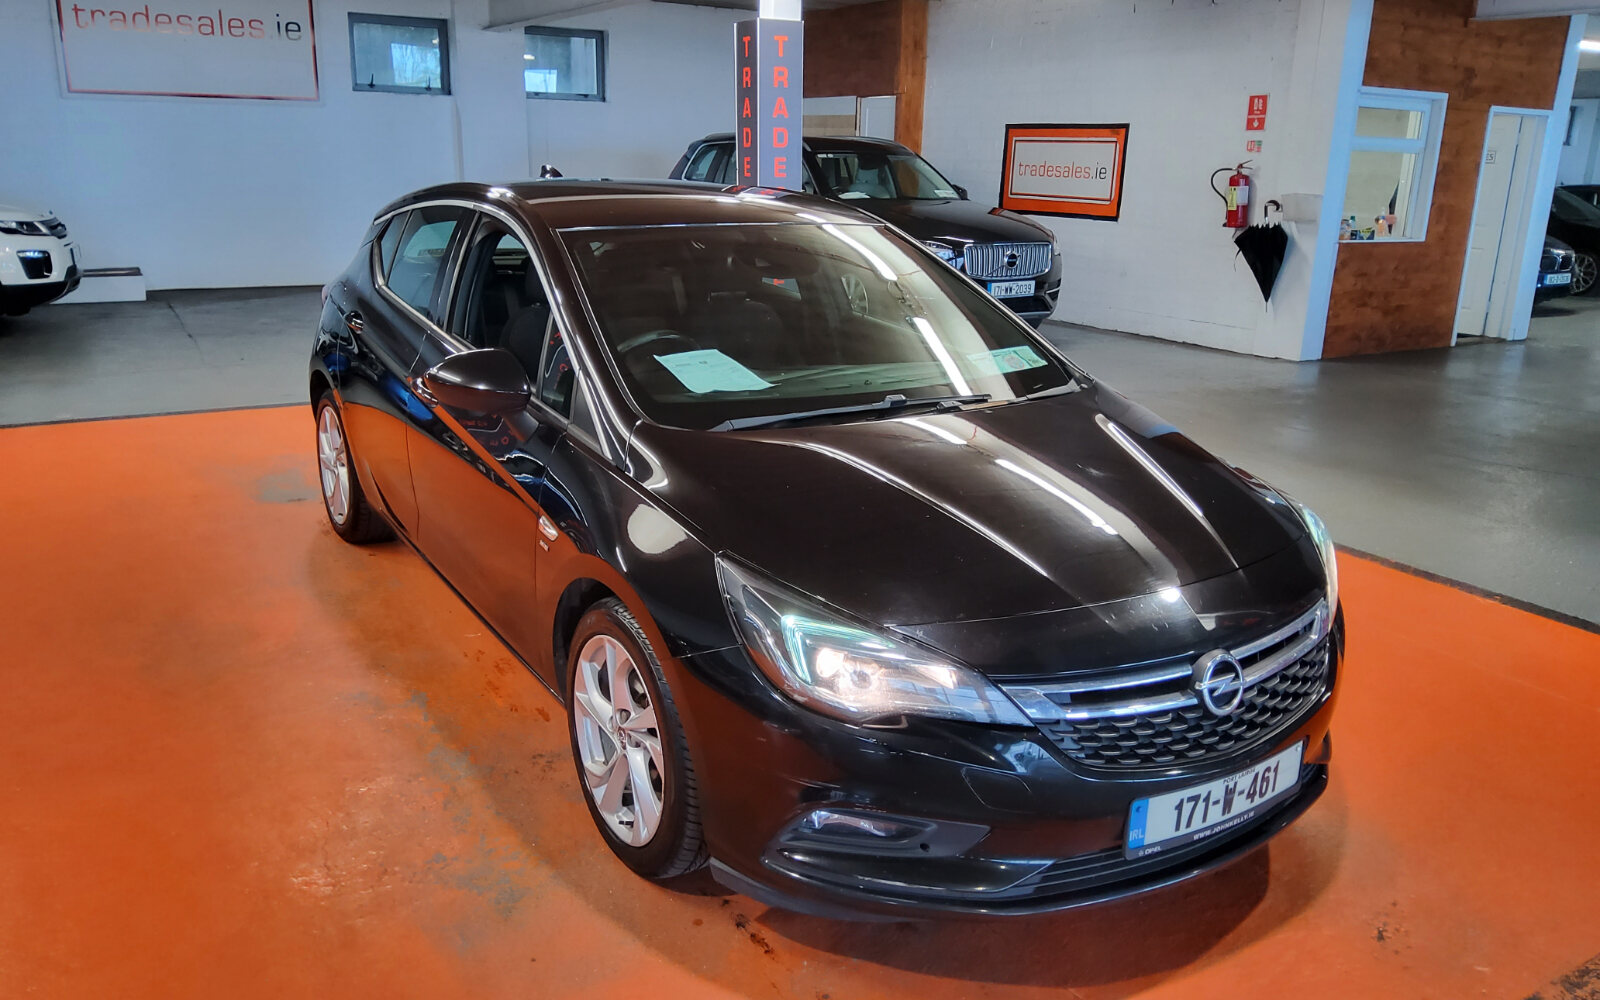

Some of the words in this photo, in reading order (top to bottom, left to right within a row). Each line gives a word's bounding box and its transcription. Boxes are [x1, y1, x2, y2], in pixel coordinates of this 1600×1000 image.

[71, 3, 302, 41] tradesales.ie
[742, 36, 752, 178] TRADE
[773, 35, 789, 190] TRADE
[1018, 160, 1107, 180] tradesales.ie
[1174, 760, 1280, 832] 171-W-461
[1129, 829, 1145, 842] IRL
